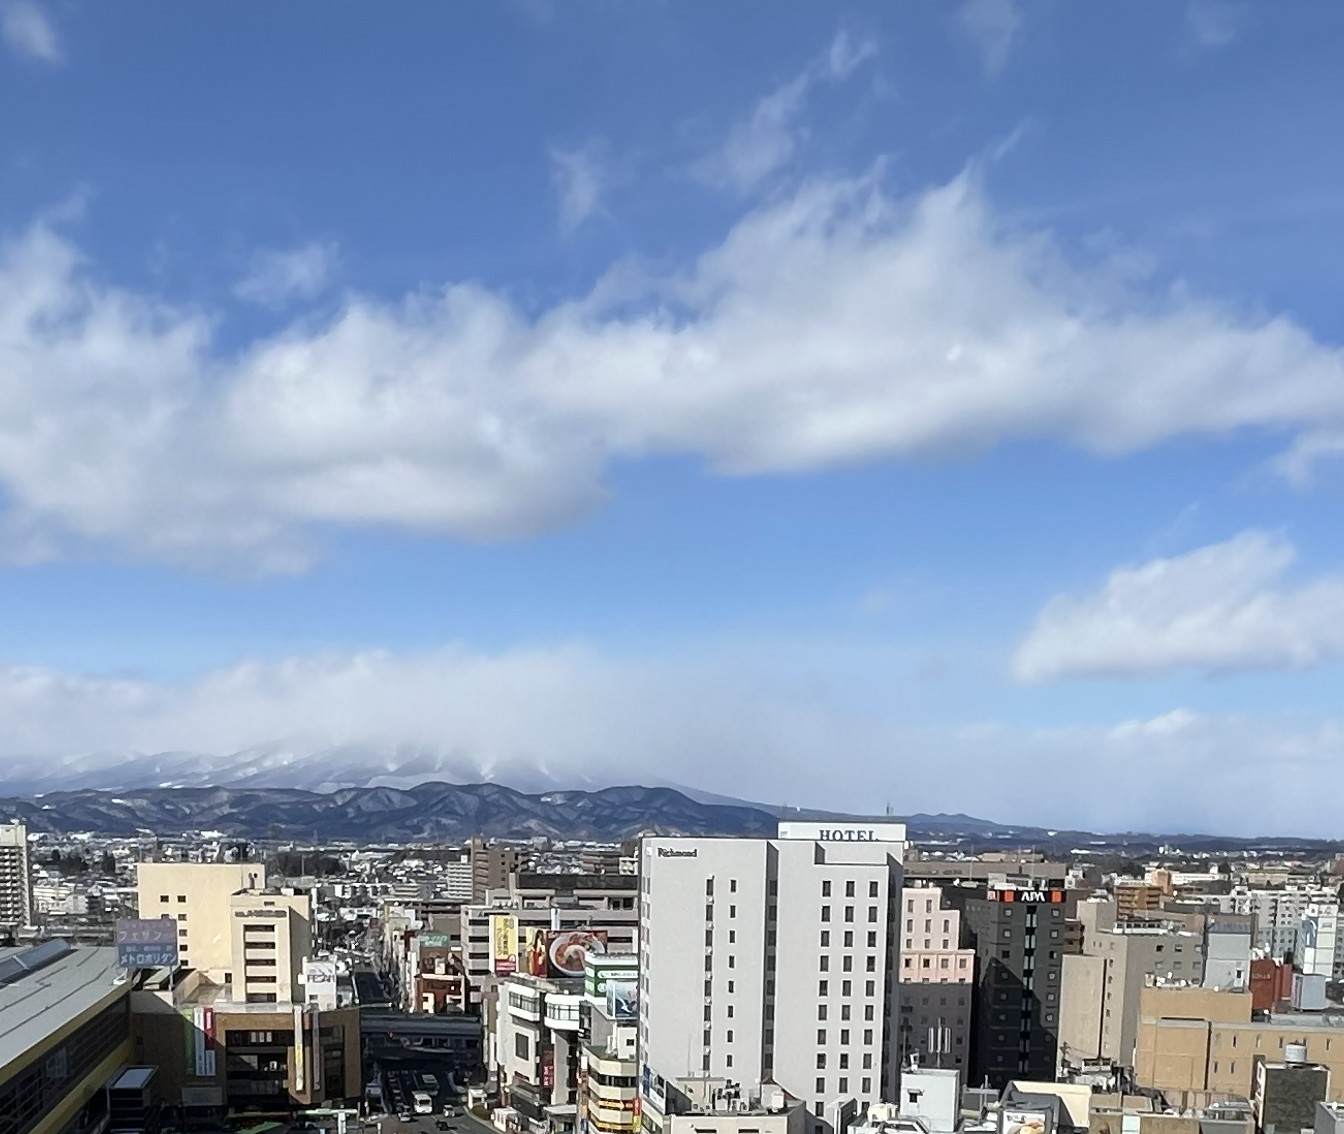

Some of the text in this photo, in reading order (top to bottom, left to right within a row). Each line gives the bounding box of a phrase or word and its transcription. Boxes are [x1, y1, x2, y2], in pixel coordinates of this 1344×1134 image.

[819, 829, 879, 842] HOTEL
[658, 848, 697, 857] Richmond
[1020, 890, 1046, 903] APA
